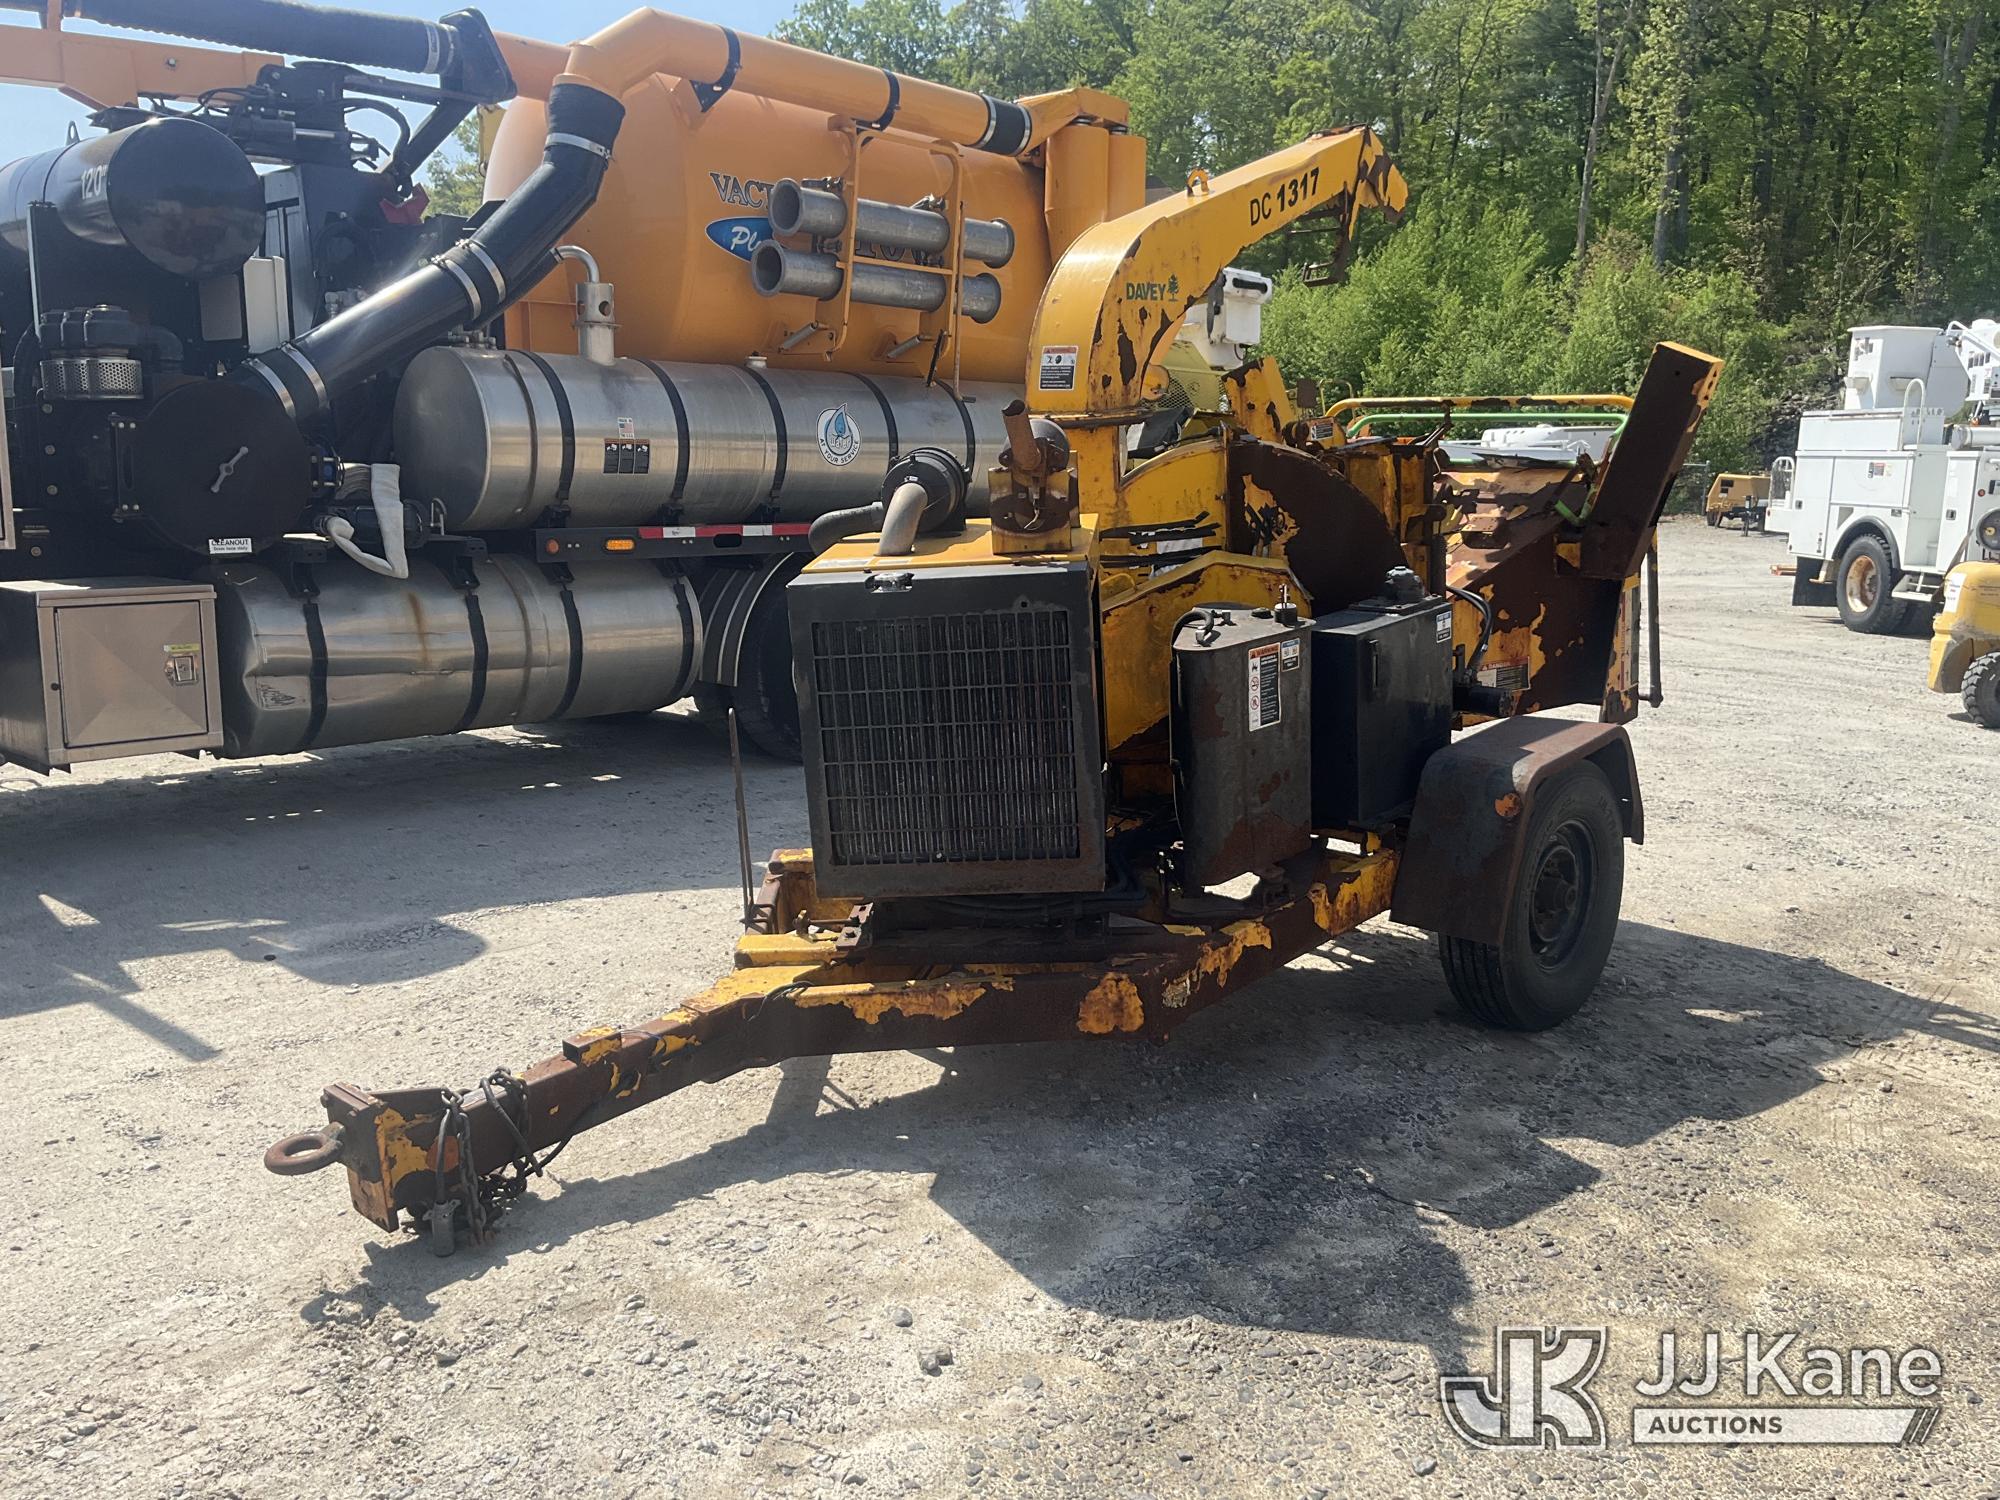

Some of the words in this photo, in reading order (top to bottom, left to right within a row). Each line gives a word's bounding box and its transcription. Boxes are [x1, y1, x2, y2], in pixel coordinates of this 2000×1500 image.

[1250, 192, 1272, 226] DC
[1277, 167, 1319, 212] 1317
[1126, 282, 1166, 300] DAVEY
[825, 449, 839, 463] YOUR
[840, 440, 859, 464] SERVICE
